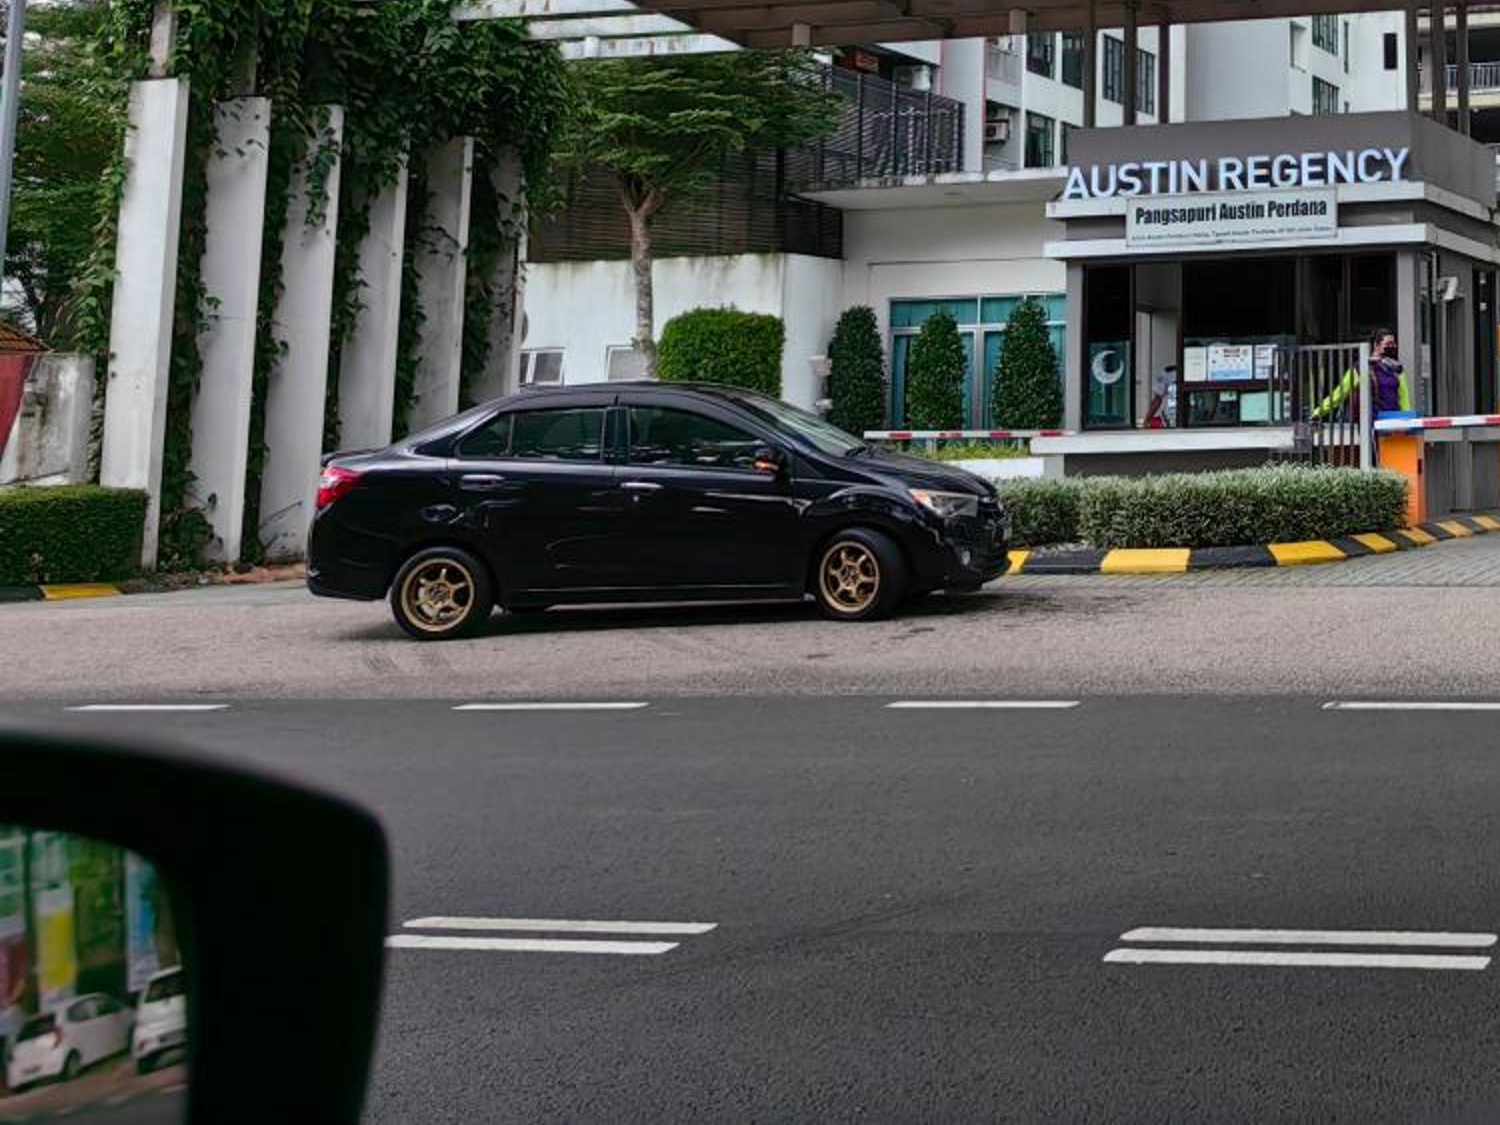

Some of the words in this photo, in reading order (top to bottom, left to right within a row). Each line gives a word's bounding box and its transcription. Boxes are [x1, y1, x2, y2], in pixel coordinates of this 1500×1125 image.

[1062, 158, 1209, 200] AUSTIN
[1218, 147, 1410, 190] REGENCY
[1135, 202, 1217, 226] Pangsapuri
[1219, 200, 1265, 221] Austin
[1267, 198, 1328, 218] Perdana
